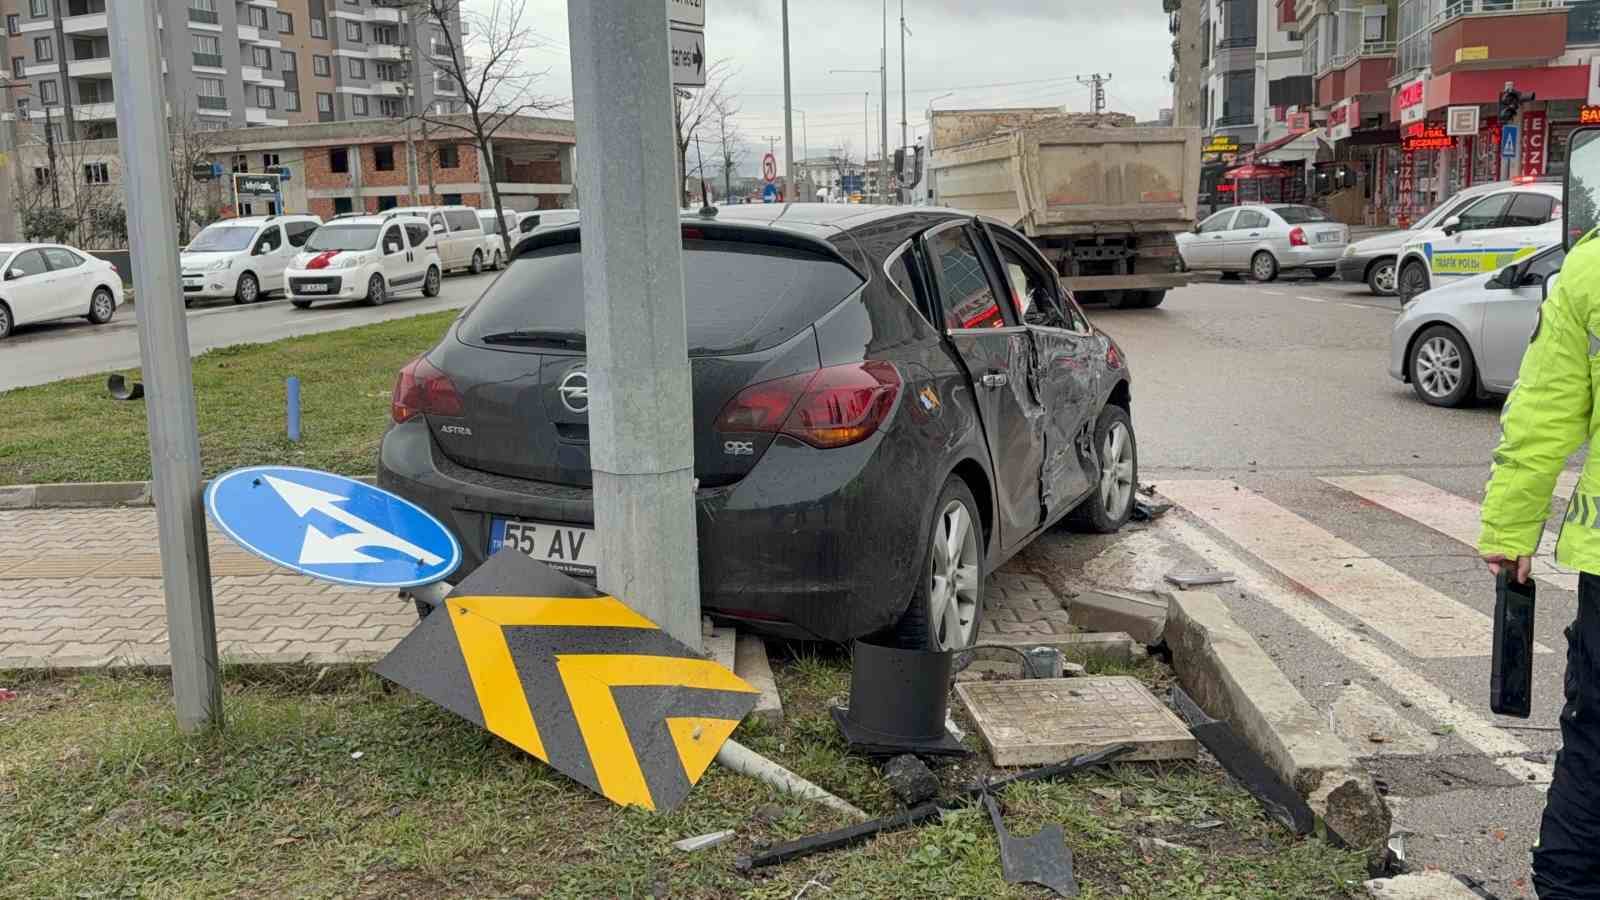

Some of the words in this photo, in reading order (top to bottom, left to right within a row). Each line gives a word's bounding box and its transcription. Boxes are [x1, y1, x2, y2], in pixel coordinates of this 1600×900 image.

[1582, 109, 1600, 121] SA
[440, 425, 473, 436] ASTRA
[505, 523, 536, 555] 55
[547, 529, 586, 560] AV
